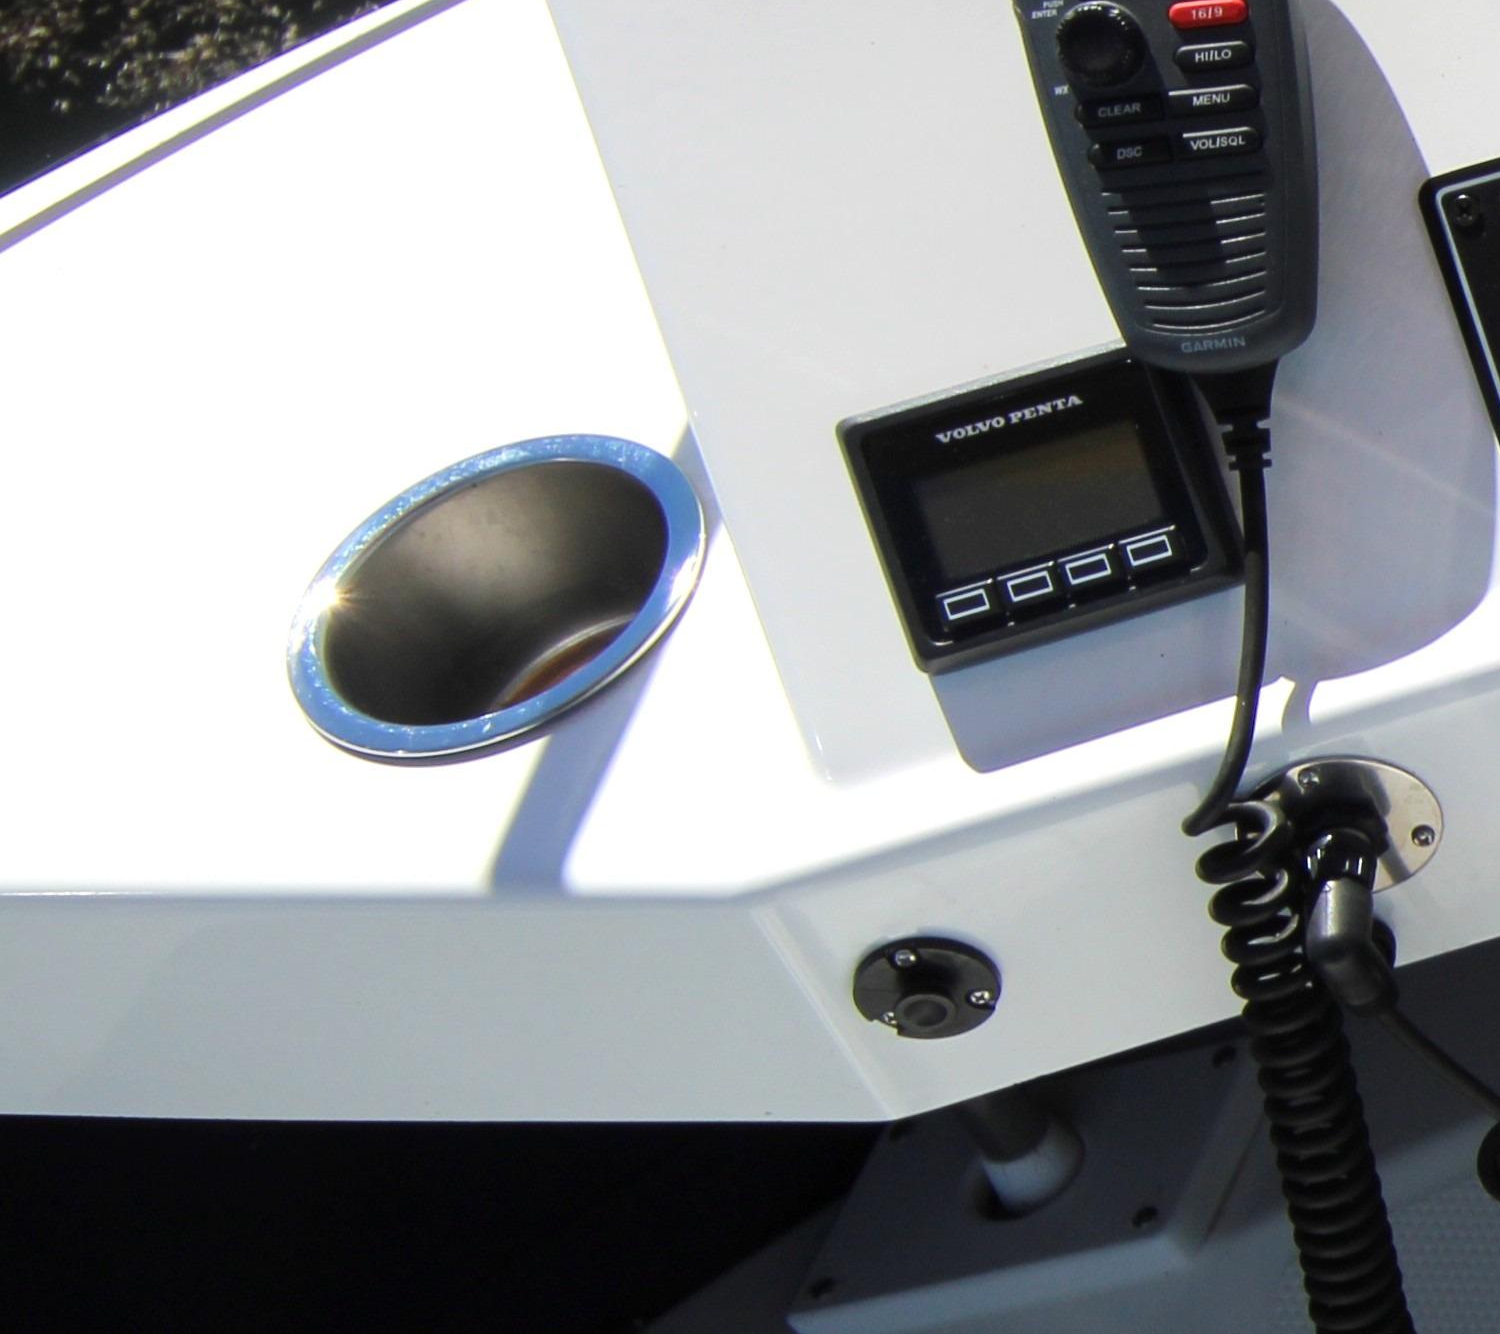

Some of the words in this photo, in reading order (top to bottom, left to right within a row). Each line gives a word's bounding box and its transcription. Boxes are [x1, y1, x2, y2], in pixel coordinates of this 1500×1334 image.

[1031, 8, 1058, 20] ENTER
[1191, 5, 1223, 20] 16/9
[1194, 47, 1233, 63] HI/LO
[1192, 91, 1231, 107] MENU
[1098, 101, 1142, 117] CLEAR
[1189, 134, 1246, 152] VOL/SQL
[1116, 145, 1143, 159] DSC
[1180, 335, 1247, 354] GARMIN
[935, 415, 1006, 444] VOLVO
[1008, 394, 1085, 426] PENTA
